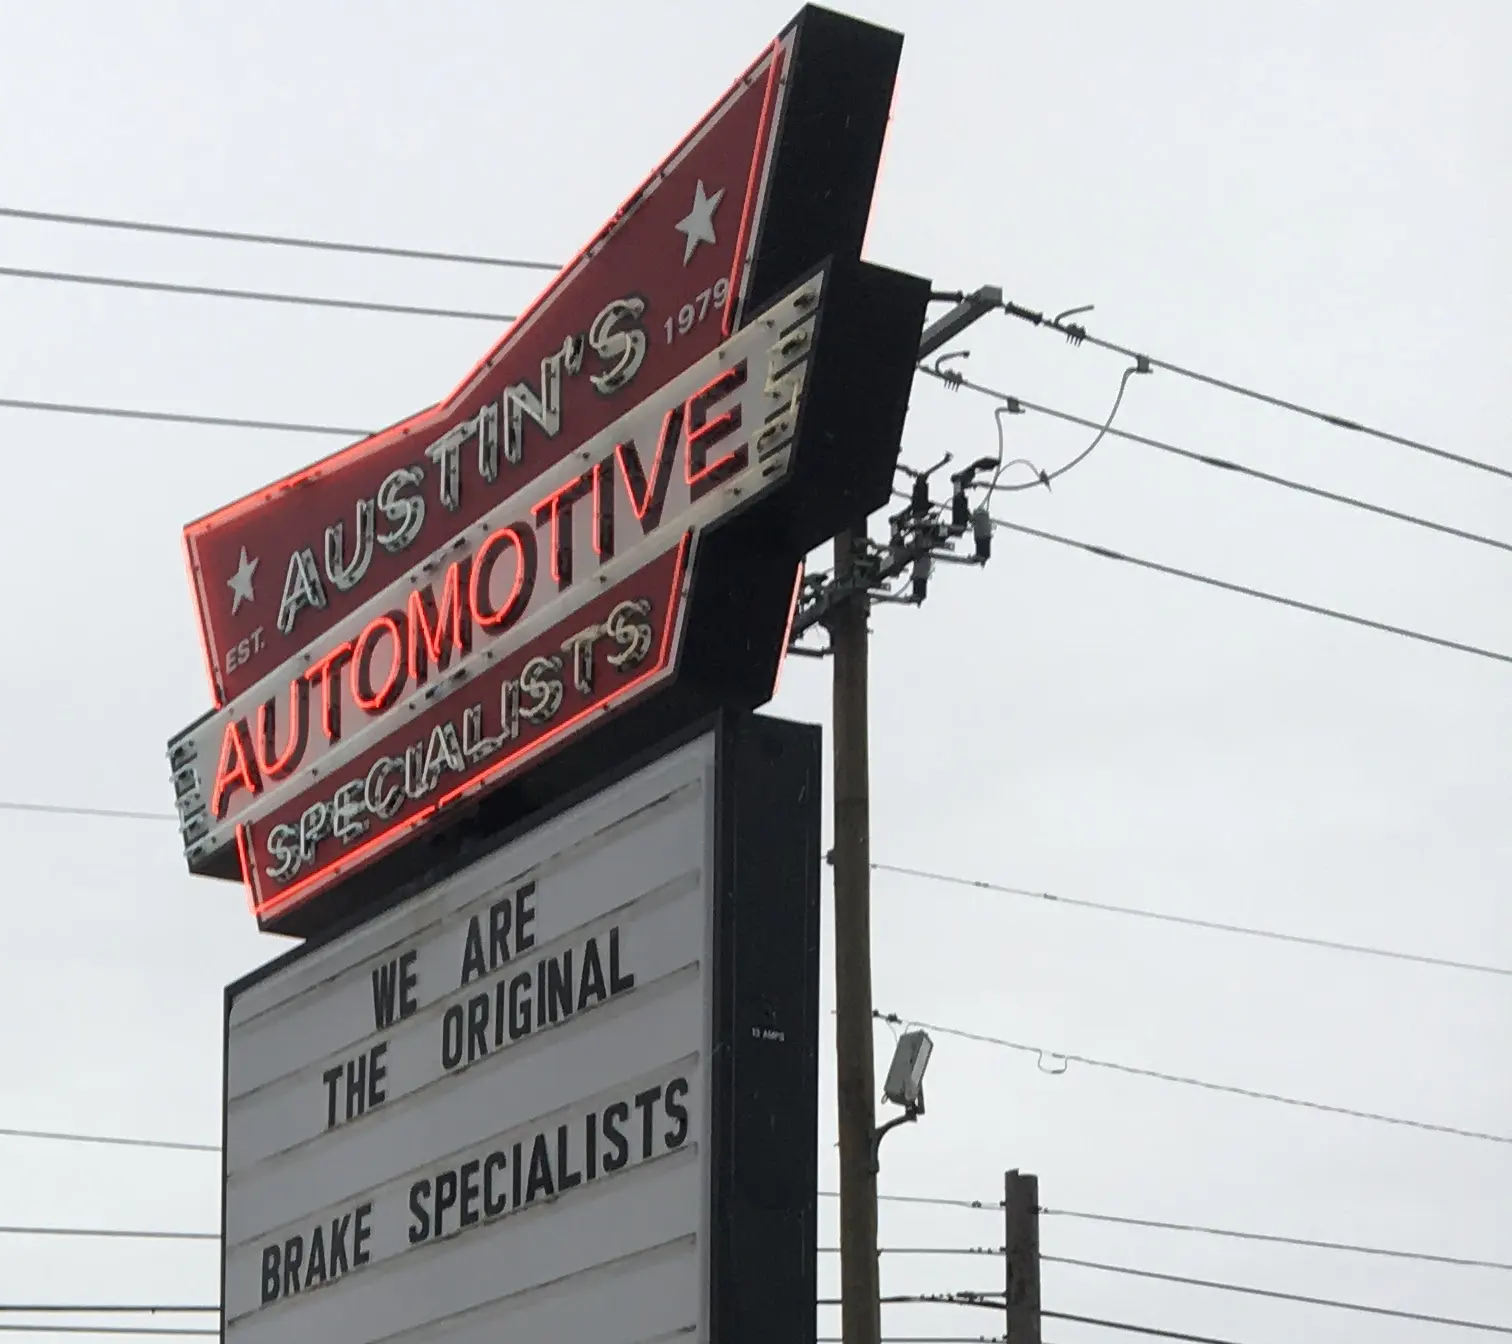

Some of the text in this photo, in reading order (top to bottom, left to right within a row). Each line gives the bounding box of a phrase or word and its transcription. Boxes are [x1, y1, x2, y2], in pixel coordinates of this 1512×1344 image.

[664, 277, 729, 344] 1979
[277, 297, 645, 634] AUSTIN'S
[211, 356, 748, 822] AUTOMOTIVE
[225, 626, 266, 674] EST.
[265, 598, 654, 885] SPECIALISTS
[323, 926, 635, 1131] THE ORIGINAL
[372, 880, 537, 1031] WE ARE
[260, 1077, 689, 1305] BRAKE SPECIALISTS
